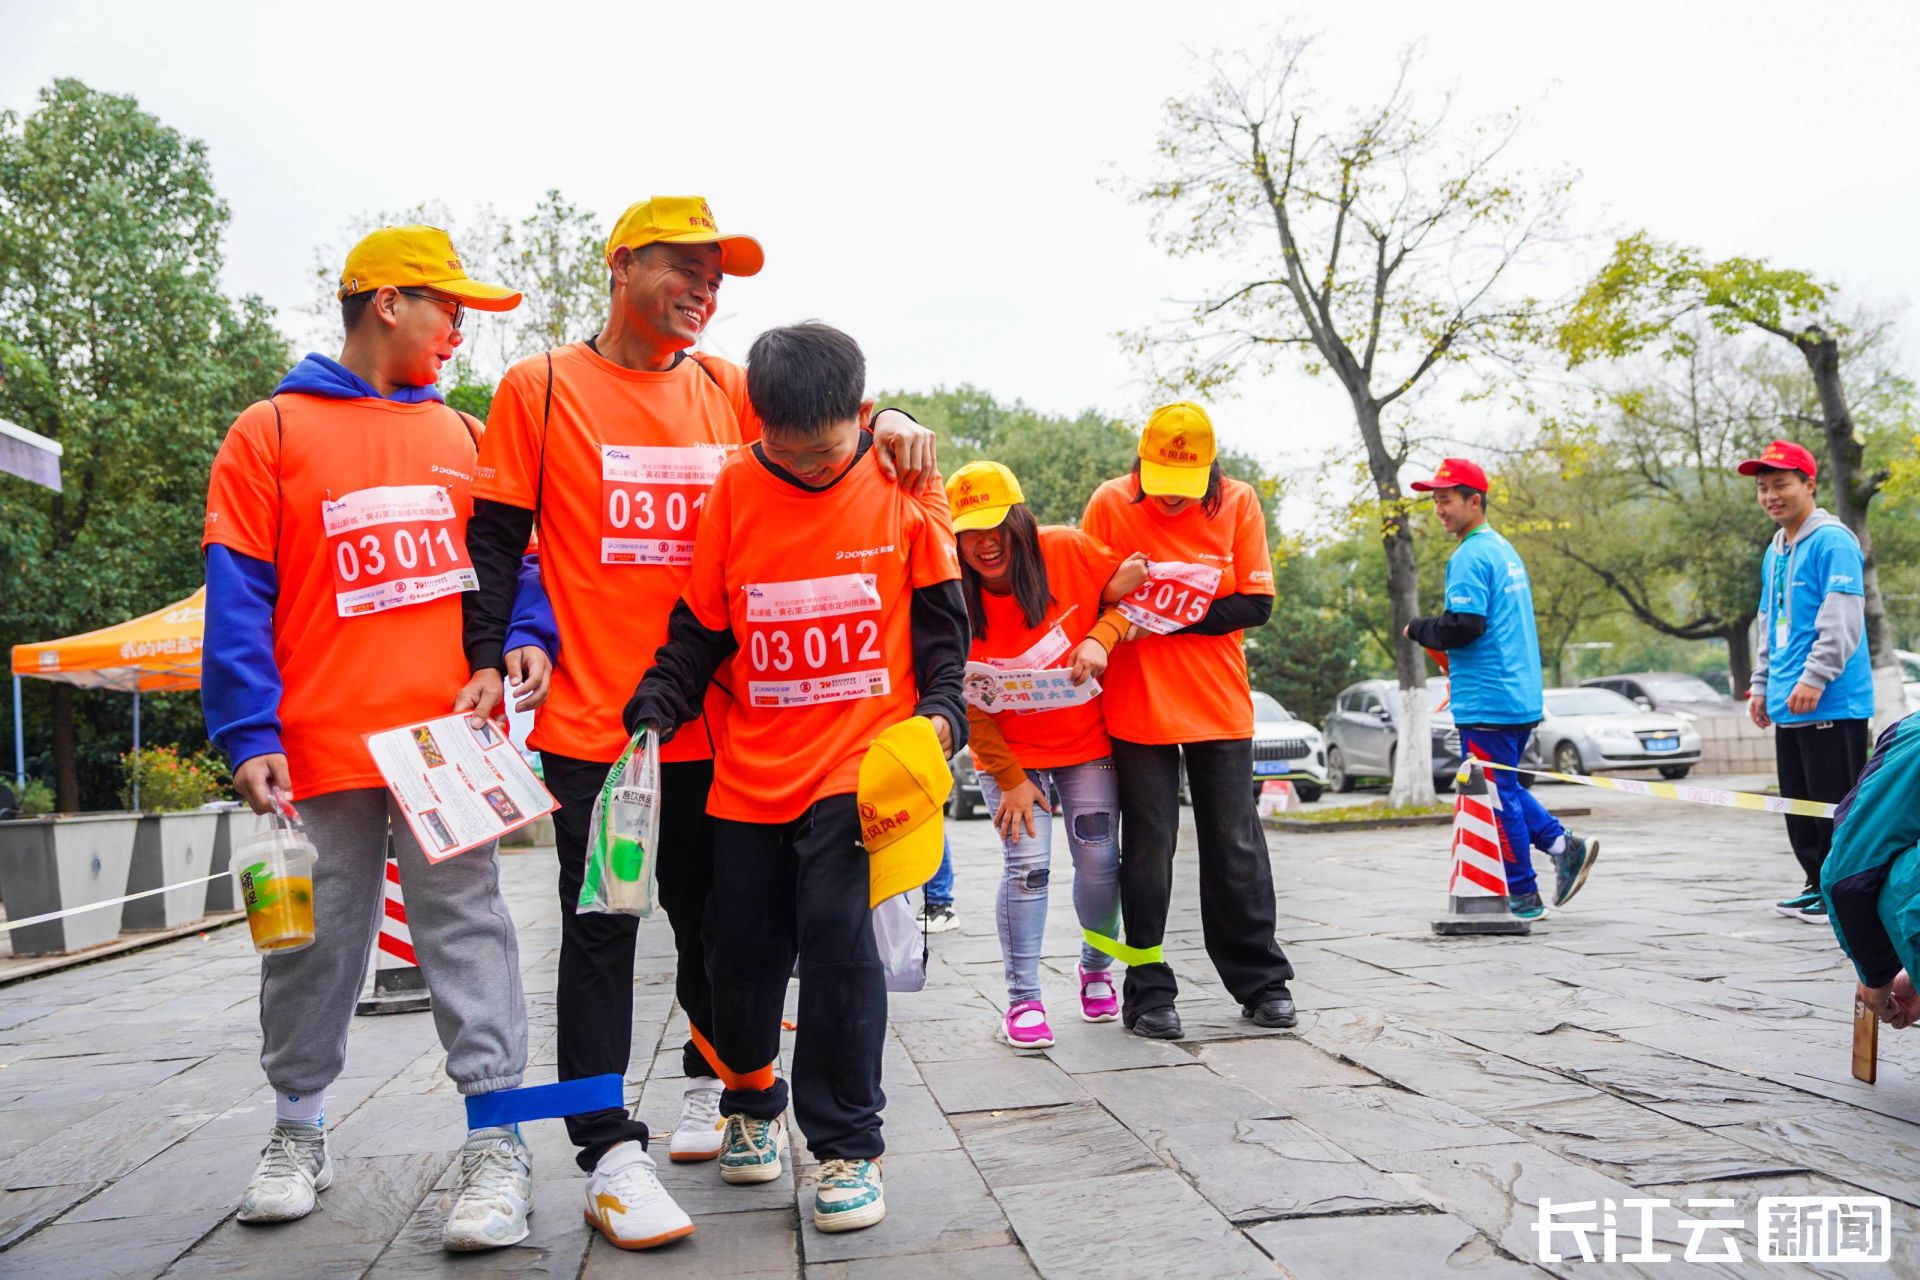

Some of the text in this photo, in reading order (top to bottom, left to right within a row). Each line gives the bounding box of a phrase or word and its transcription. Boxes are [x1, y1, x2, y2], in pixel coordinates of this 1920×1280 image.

[688, 216, 718, 232] 东风
[609, 488, 656, 530] 03
[336, 527, 459, 582] 03 011
[1154, 583, 1209, 622] 015
[751, 619, 882, 673] 03 012
